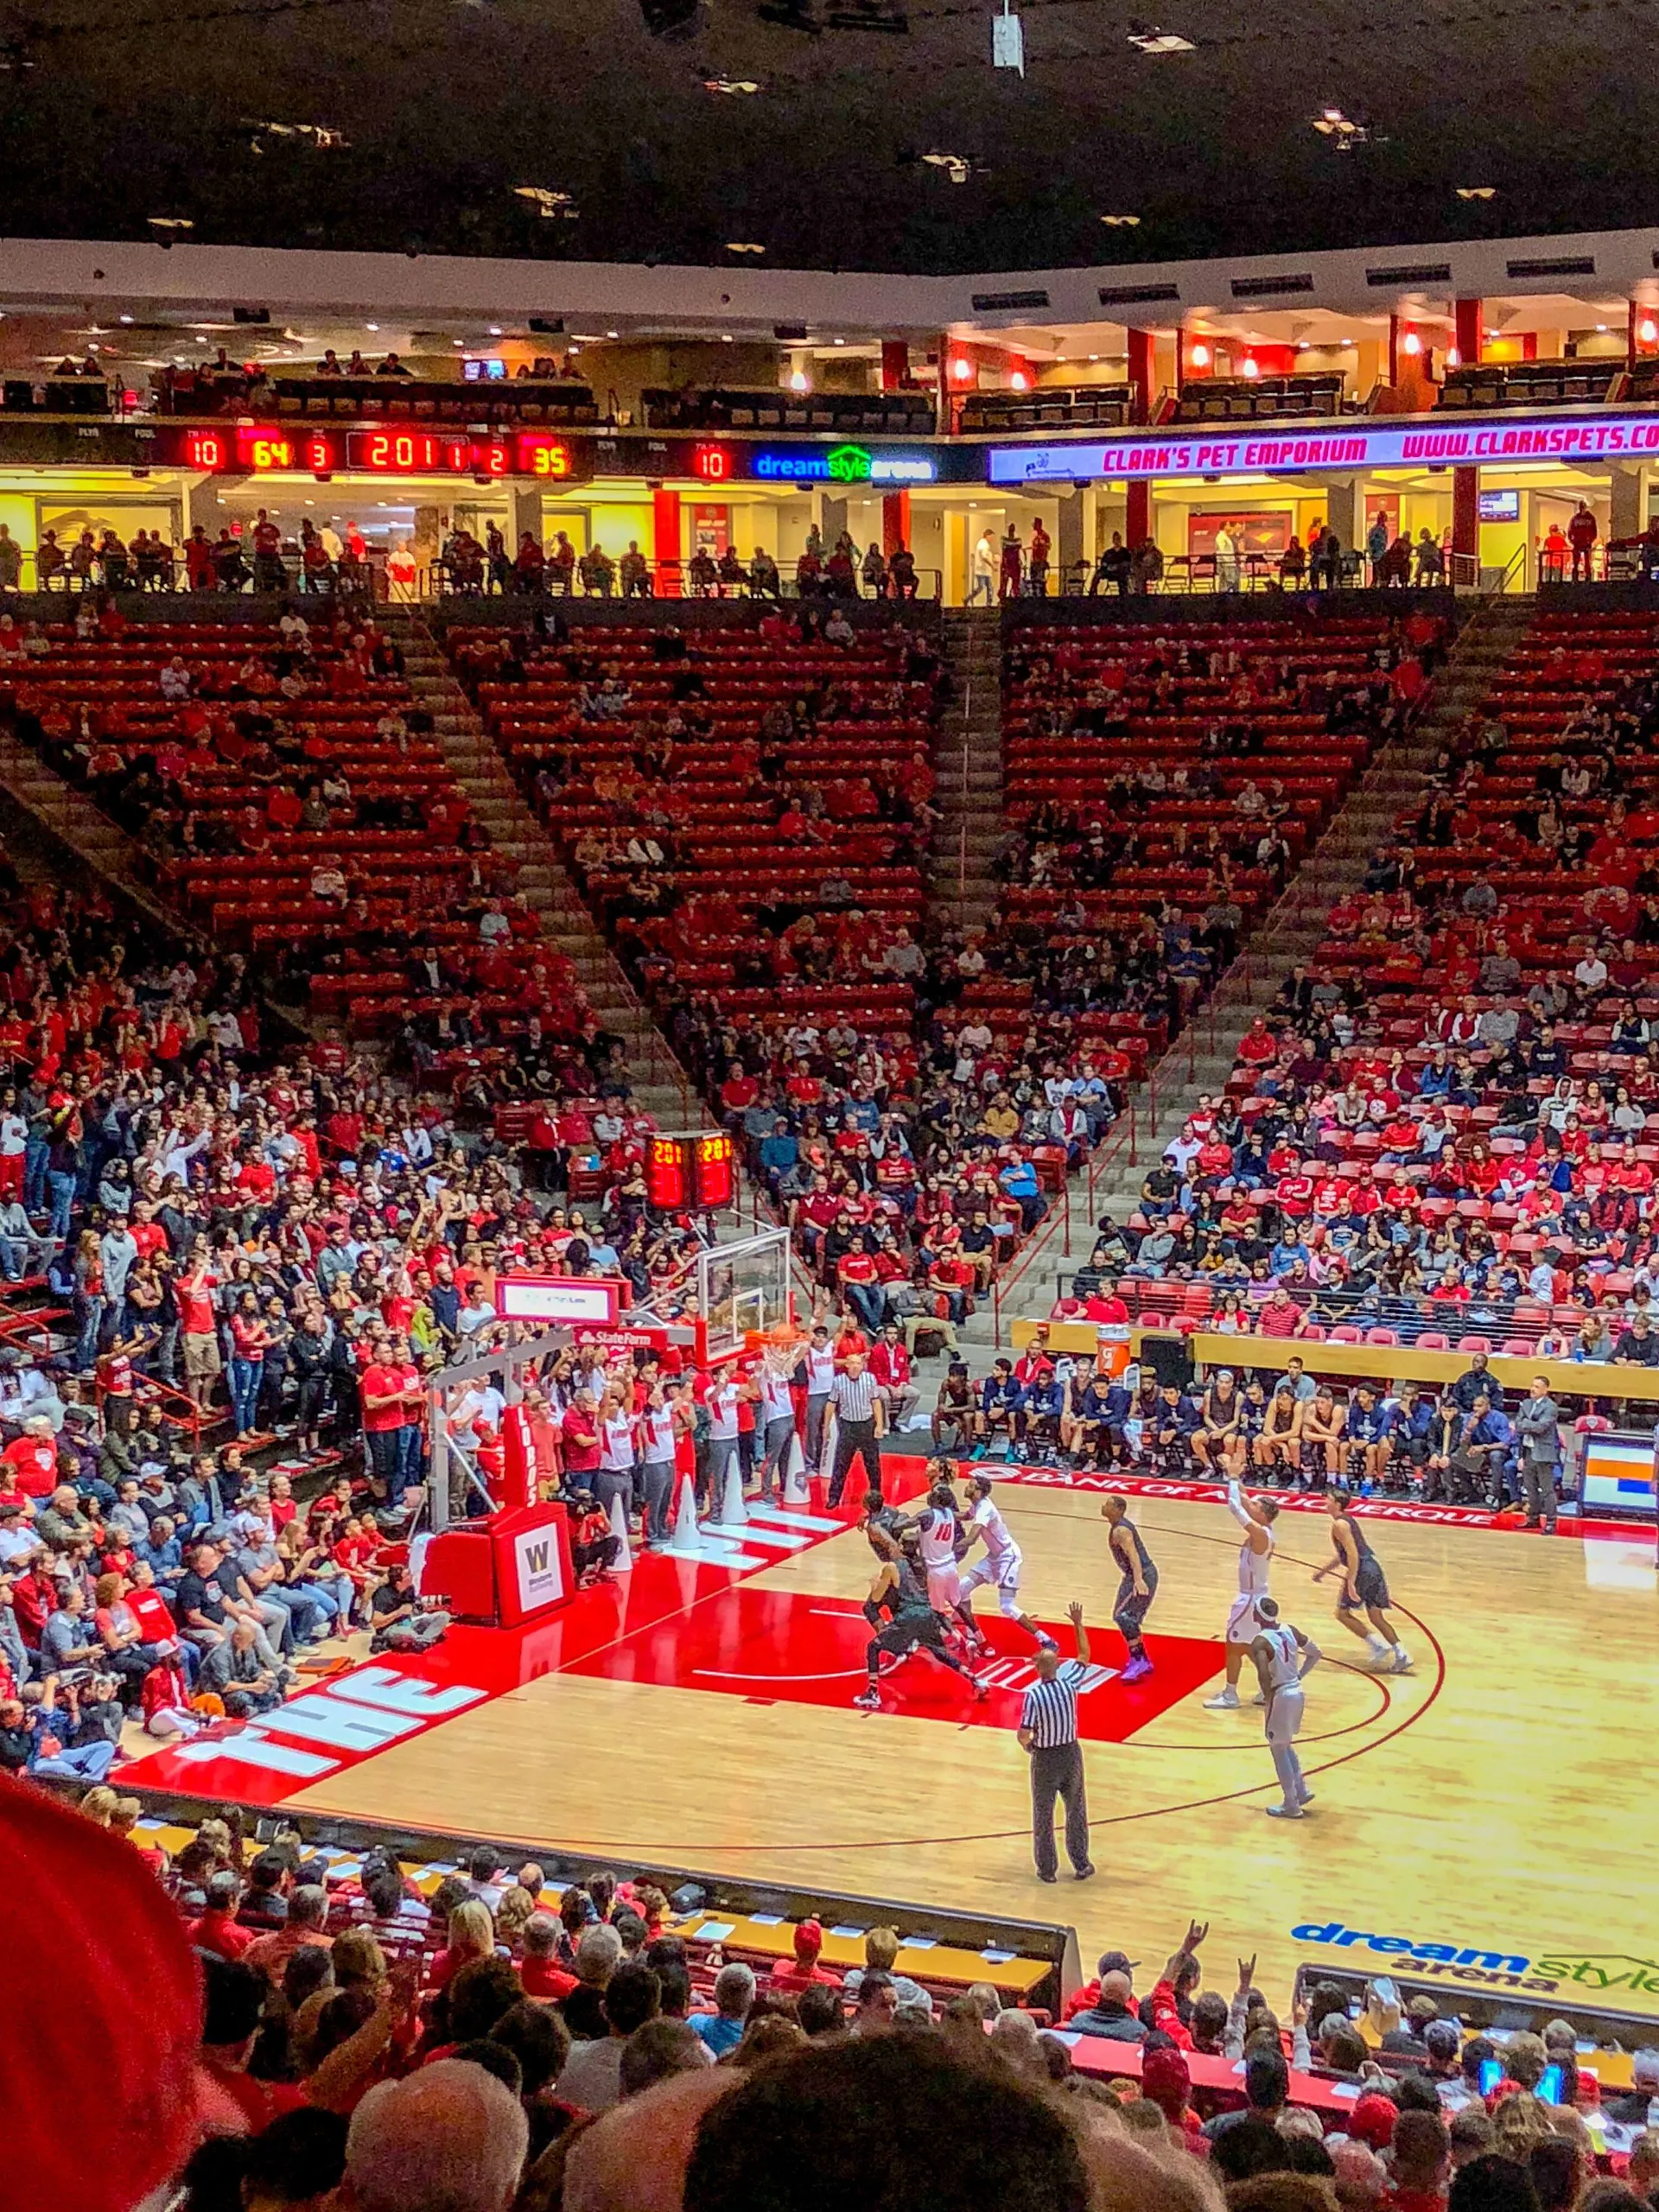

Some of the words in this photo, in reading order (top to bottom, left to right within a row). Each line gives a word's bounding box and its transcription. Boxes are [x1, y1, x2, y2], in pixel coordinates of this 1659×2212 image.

[194, 441, 218, 465] 10
[254, 441, 289, 467] 64
[314, 444, 326, 467] 3
[491, 448, 504, 472] 2
[535, 447, 566, 474] 35
[702, 453, 722, 477] 10
[1103, 447, 1190, 473] CLARK'S
[1197, 443, 1239, 467] PET
[1244, 437, 1368, 465] EMPORIUM
[517, 1405, 537, 1509] LOBOS
[1022, 1471, 1133, 1491] BANK
[1141, 1483, 1197, 1497] OF
[1197, 1489, 1497, 1526] AUQUERQUE
[934, 1522, 952, 1542] 10
[524, 1540, 549, 1574] W
[173, 1666, 489, 1778] THE
[1390, 1956, 1560, 1993] arena
